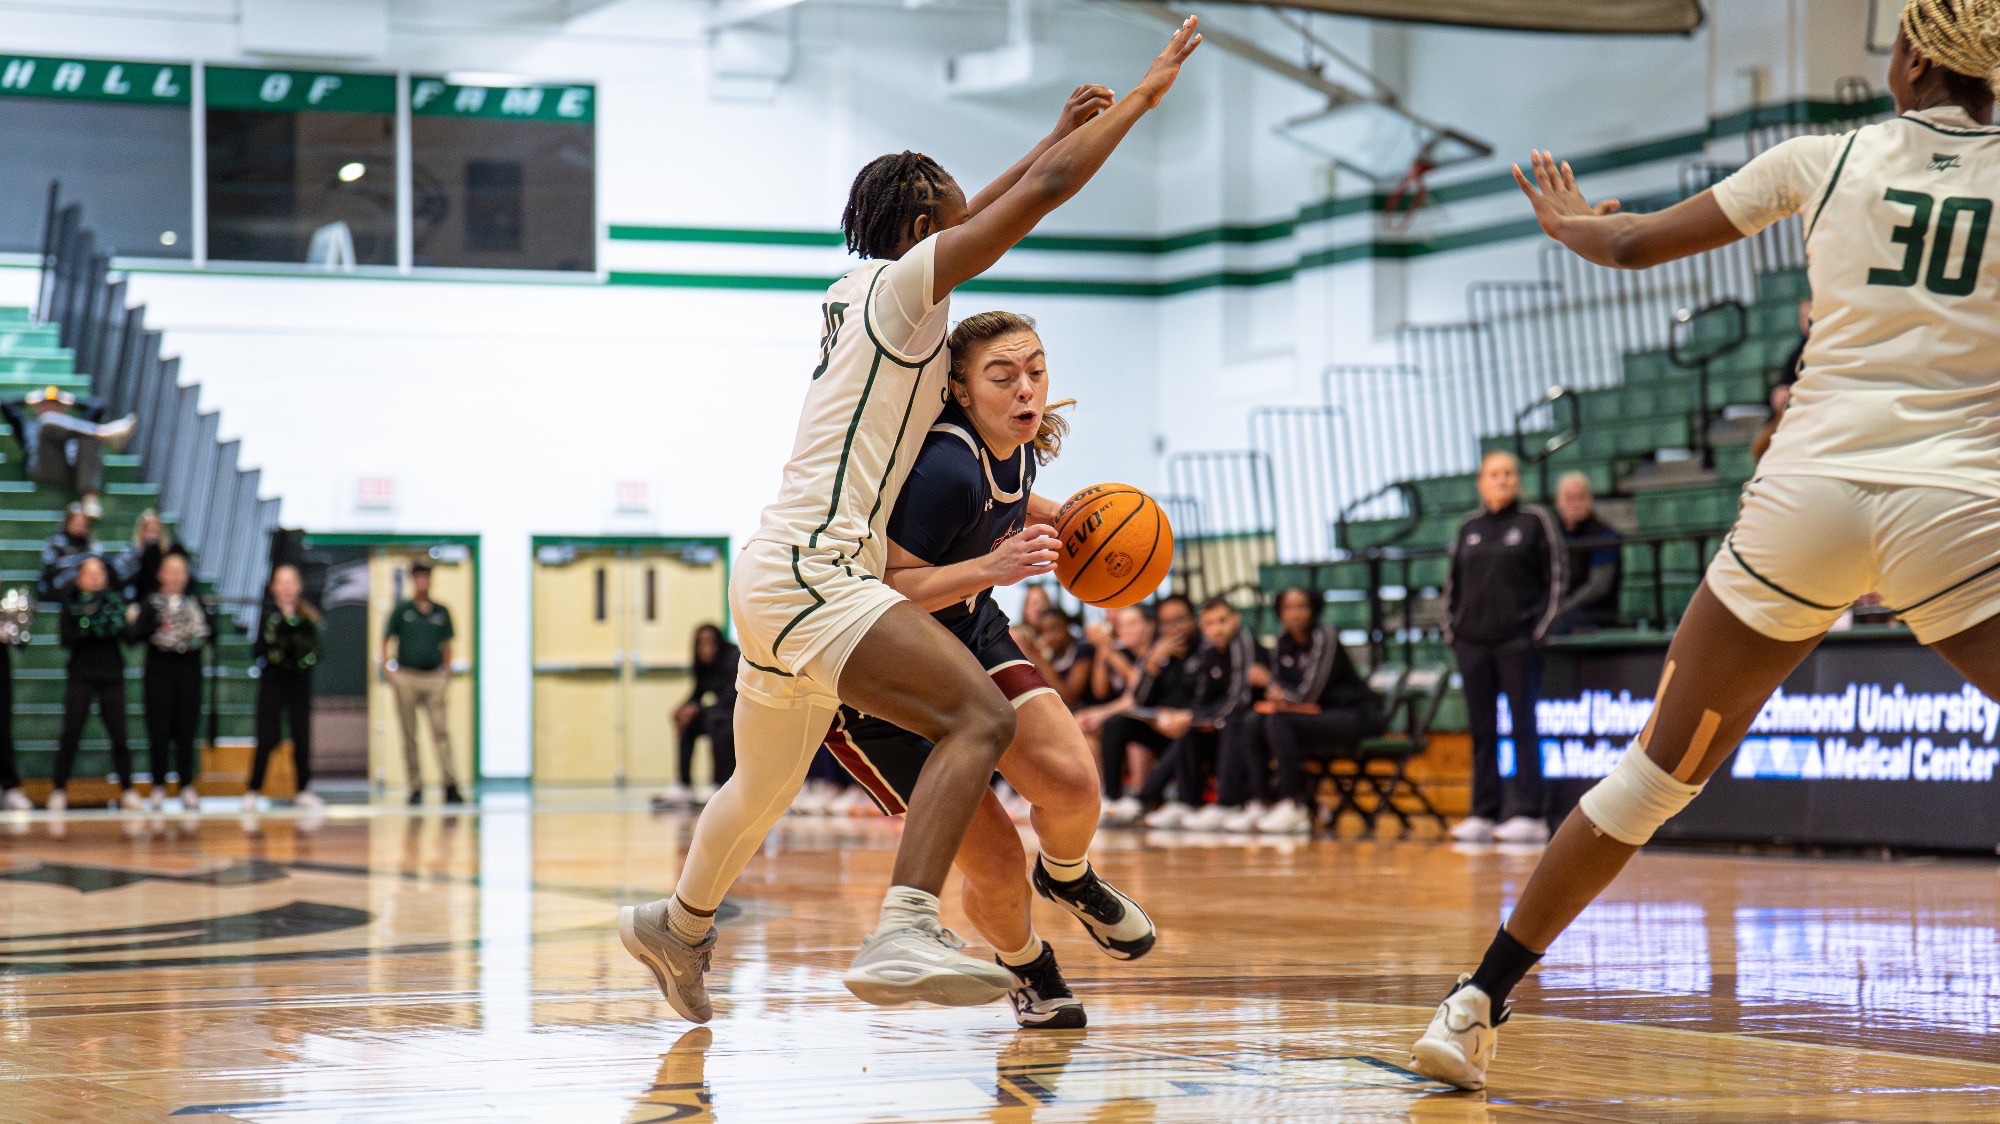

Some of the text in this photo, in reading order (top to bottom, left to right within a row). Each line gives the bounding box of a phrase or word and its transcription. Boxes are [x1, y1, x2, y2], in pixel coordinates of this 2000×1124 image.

[1, 59, 592, 118] HALL OF FAME
[1866, 186, 1993, 297] 30
[1065, 510, 1103, 559] EVO
[1857, 682, 2000, 743] University
[1822, 736, 2000, 781] Medical Center
